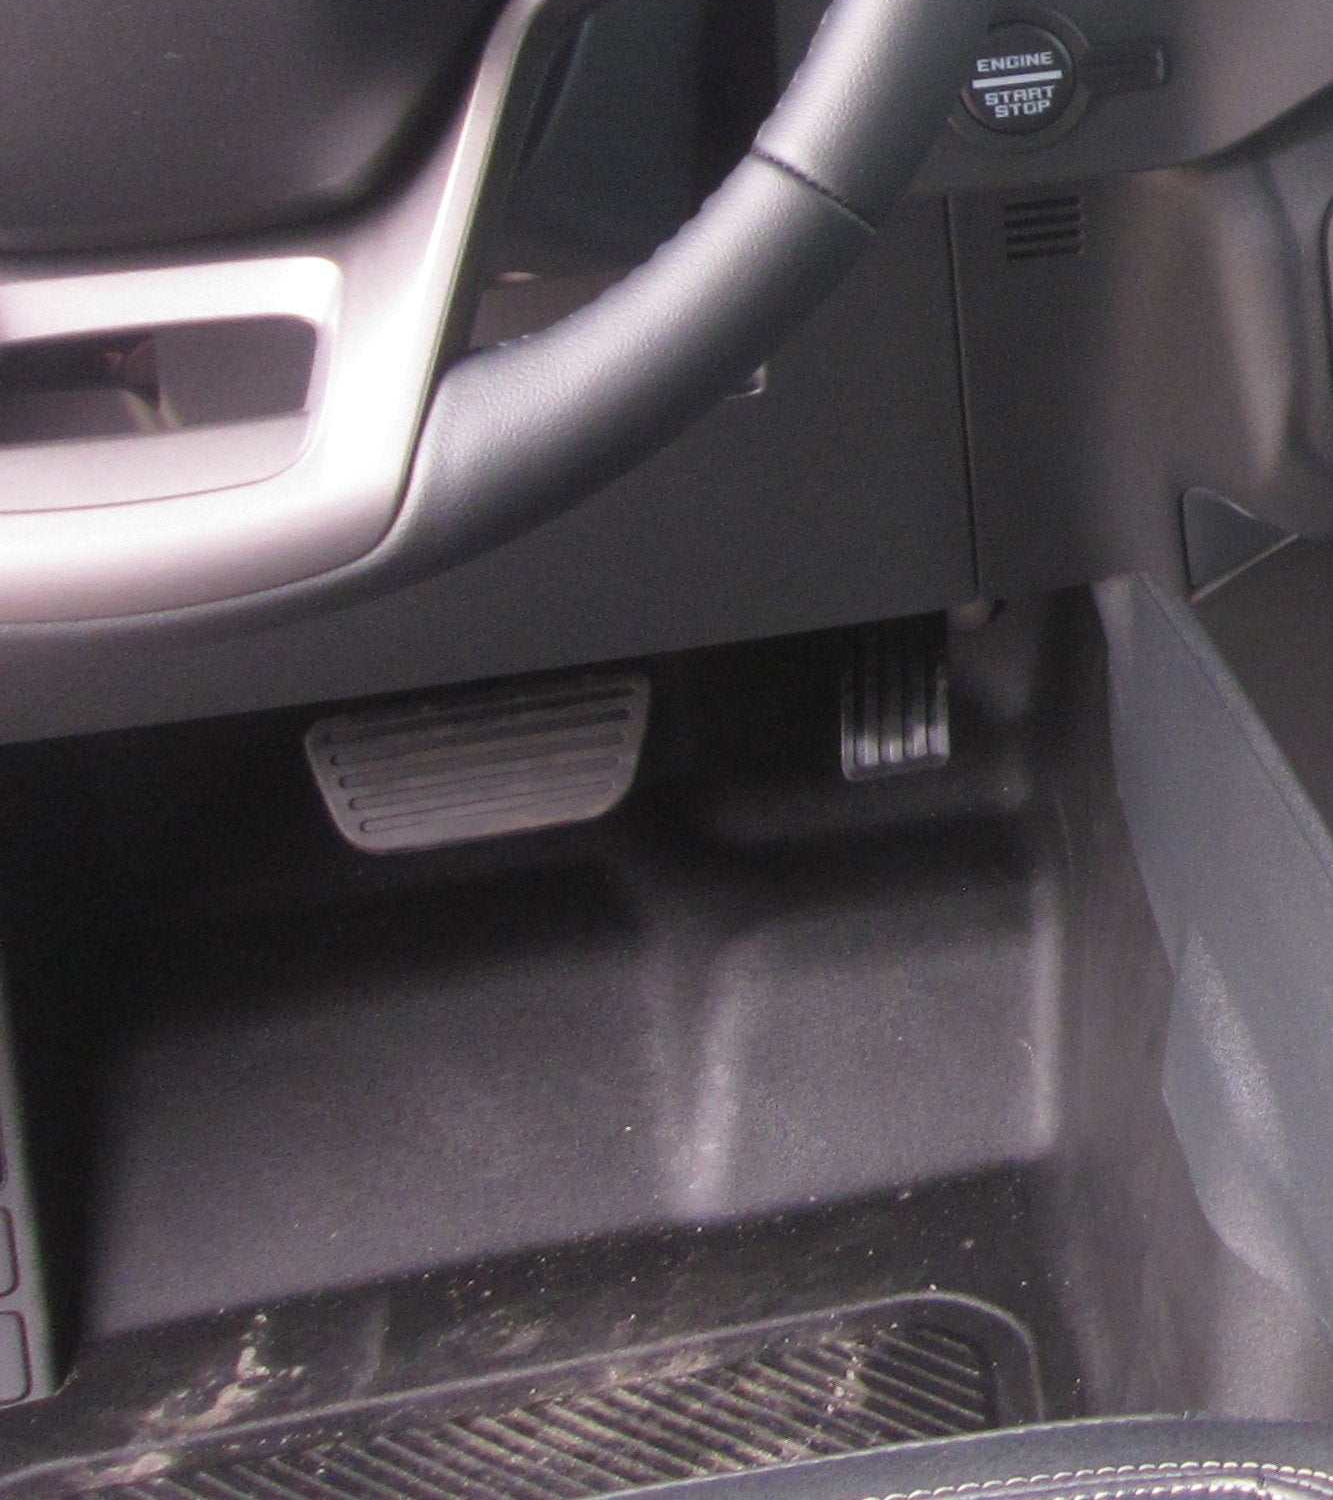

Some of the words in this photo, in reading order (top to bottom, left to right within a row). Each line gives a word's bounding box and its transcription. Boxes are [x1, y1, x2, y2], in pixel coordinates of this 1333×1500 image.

[976, 50, 1053, 73] ENGINE
[984, 85, 1056, 107] START
[994, 100, 1051, 118] STOP
